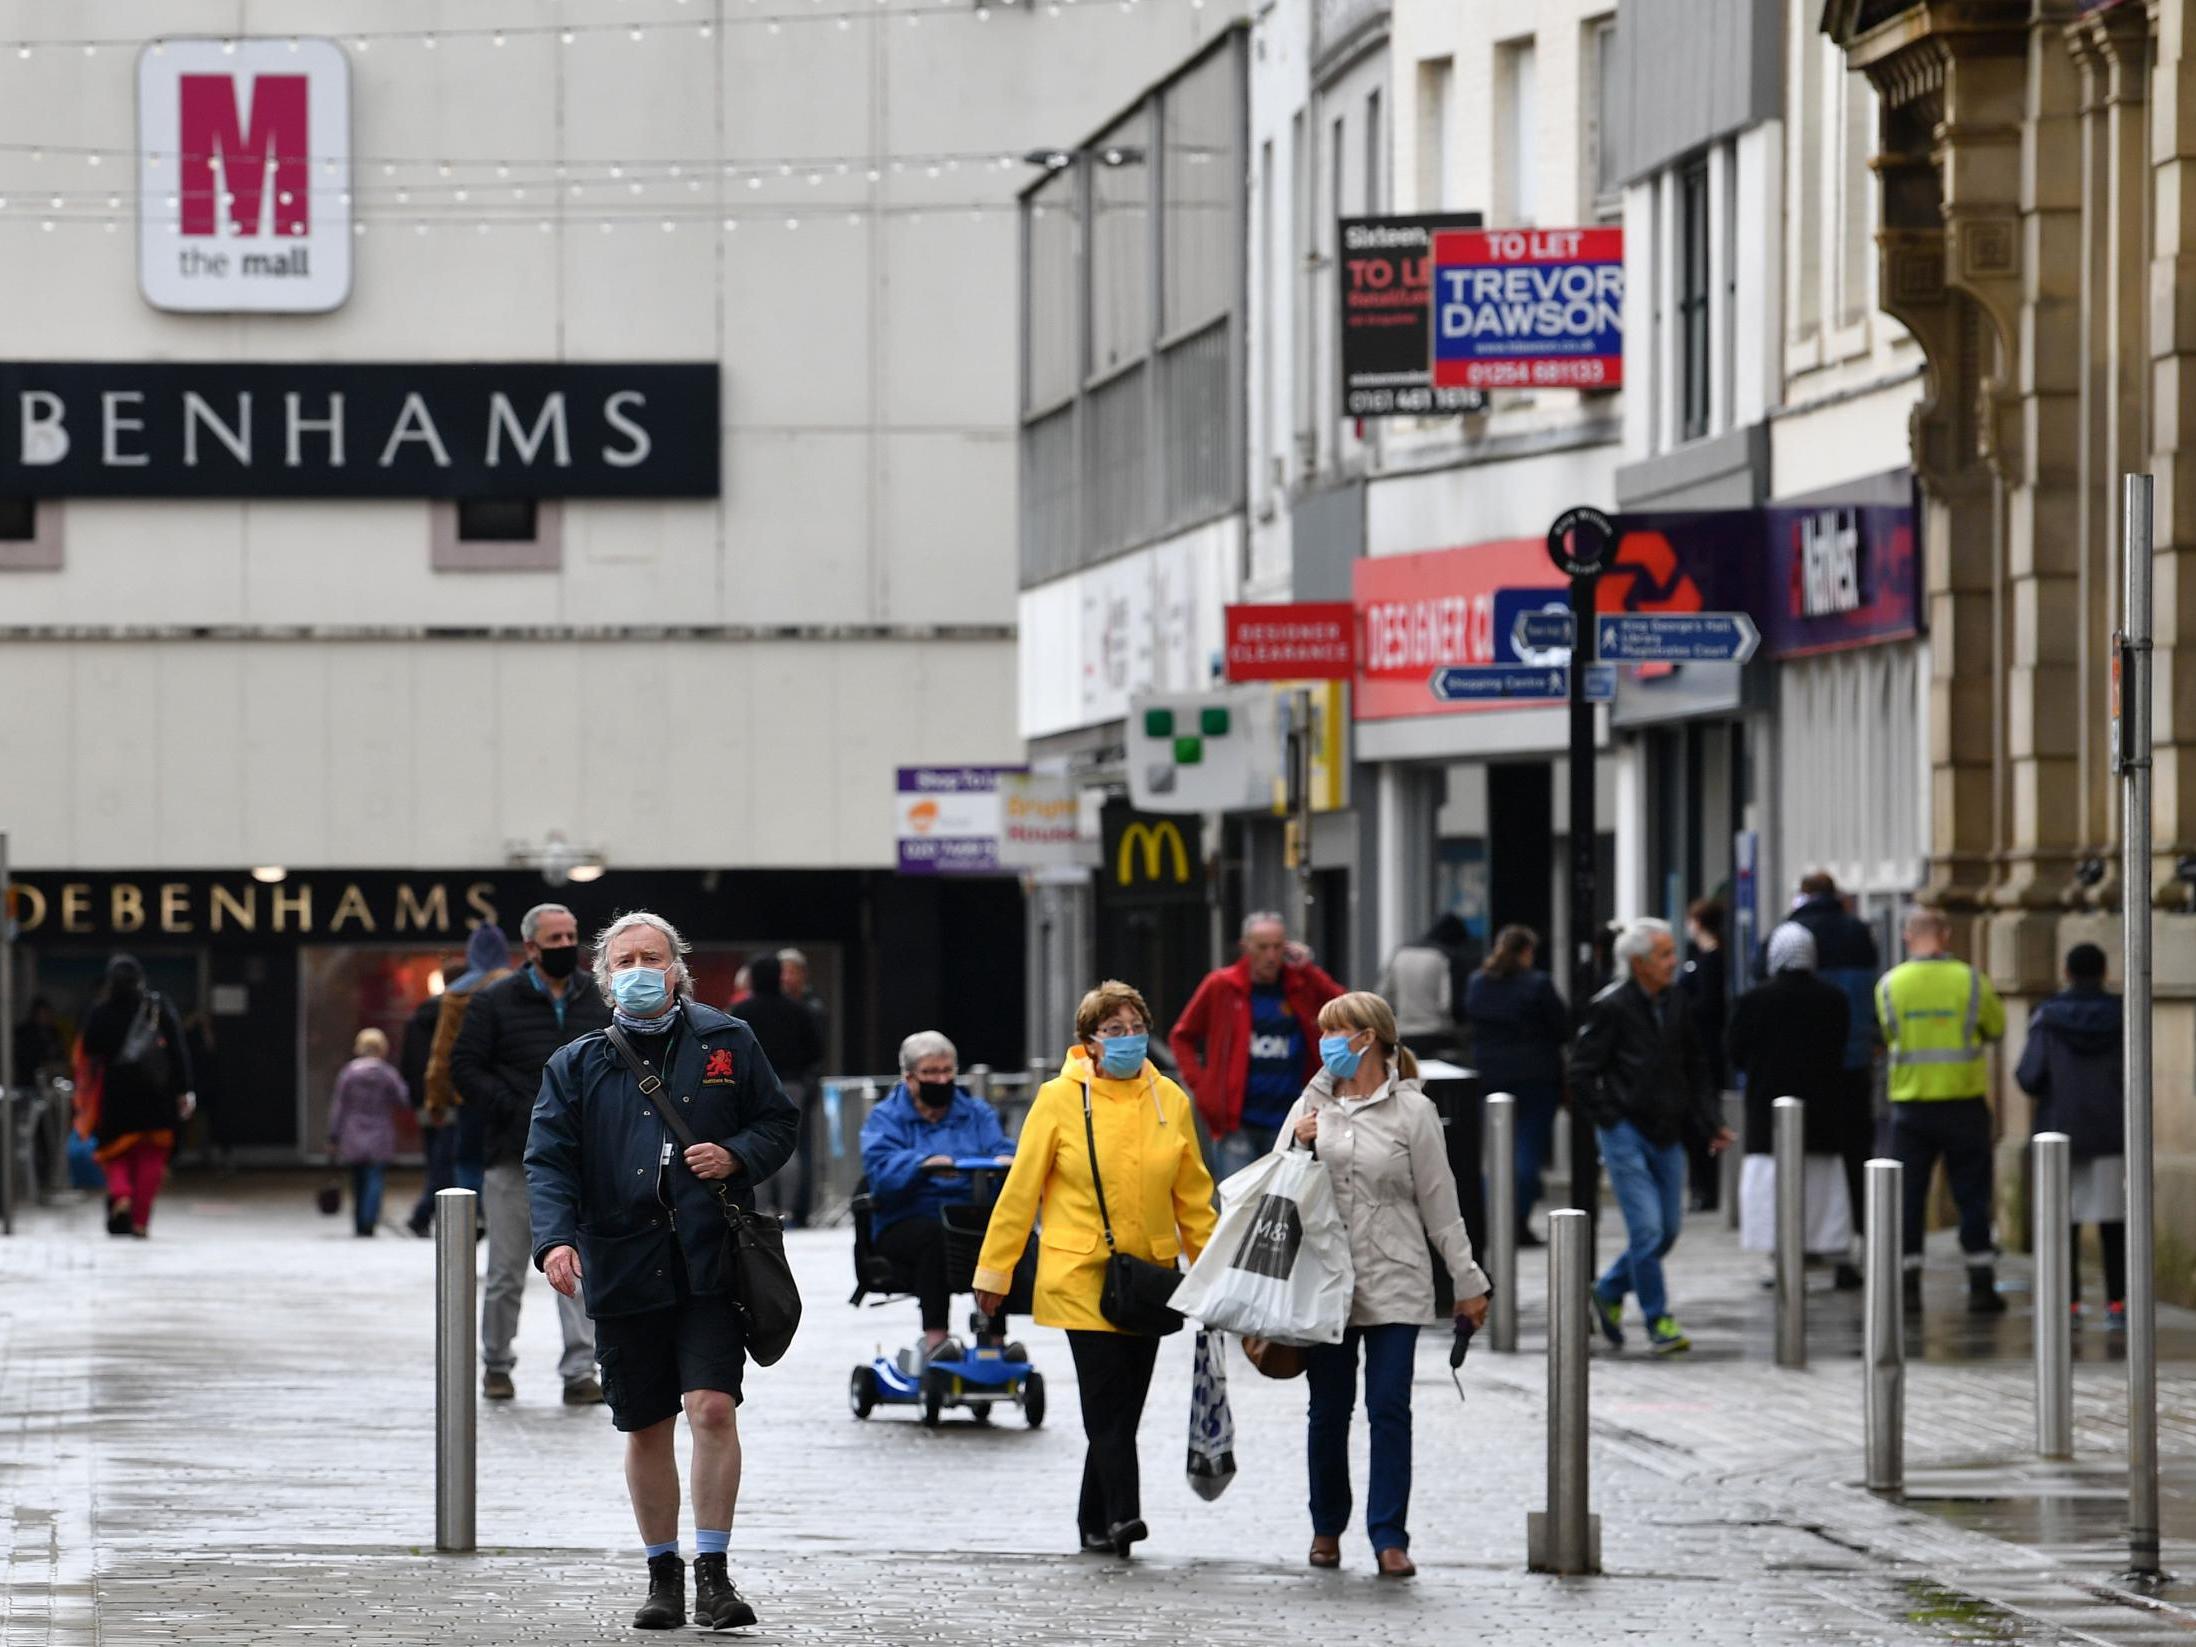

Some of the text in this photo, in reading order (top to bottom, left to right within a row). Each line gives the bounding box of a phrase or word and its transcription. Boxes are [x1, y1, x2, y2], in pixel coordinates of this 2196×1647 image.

[1485, 231, 1584, 260] TO LET
[180, 247, 310, 278] the mall
[1347, 258, 1394, 289] TO
[1442, 265, 1624, 303] TREVOR
[1442, 301, 1624, 338] DAWSON
[19, 389, 652, 467] BENHAMS
[1238, 623, 1340, 641] DESIGNER
[1368, 596, 1467, 670] DESIGNER
[1231, 643, 1349, 662] CLEARANCE
[1448, 676, 1546, 690] Shopping Centre
[6, 882, 499, 933] DEBENHAMS
